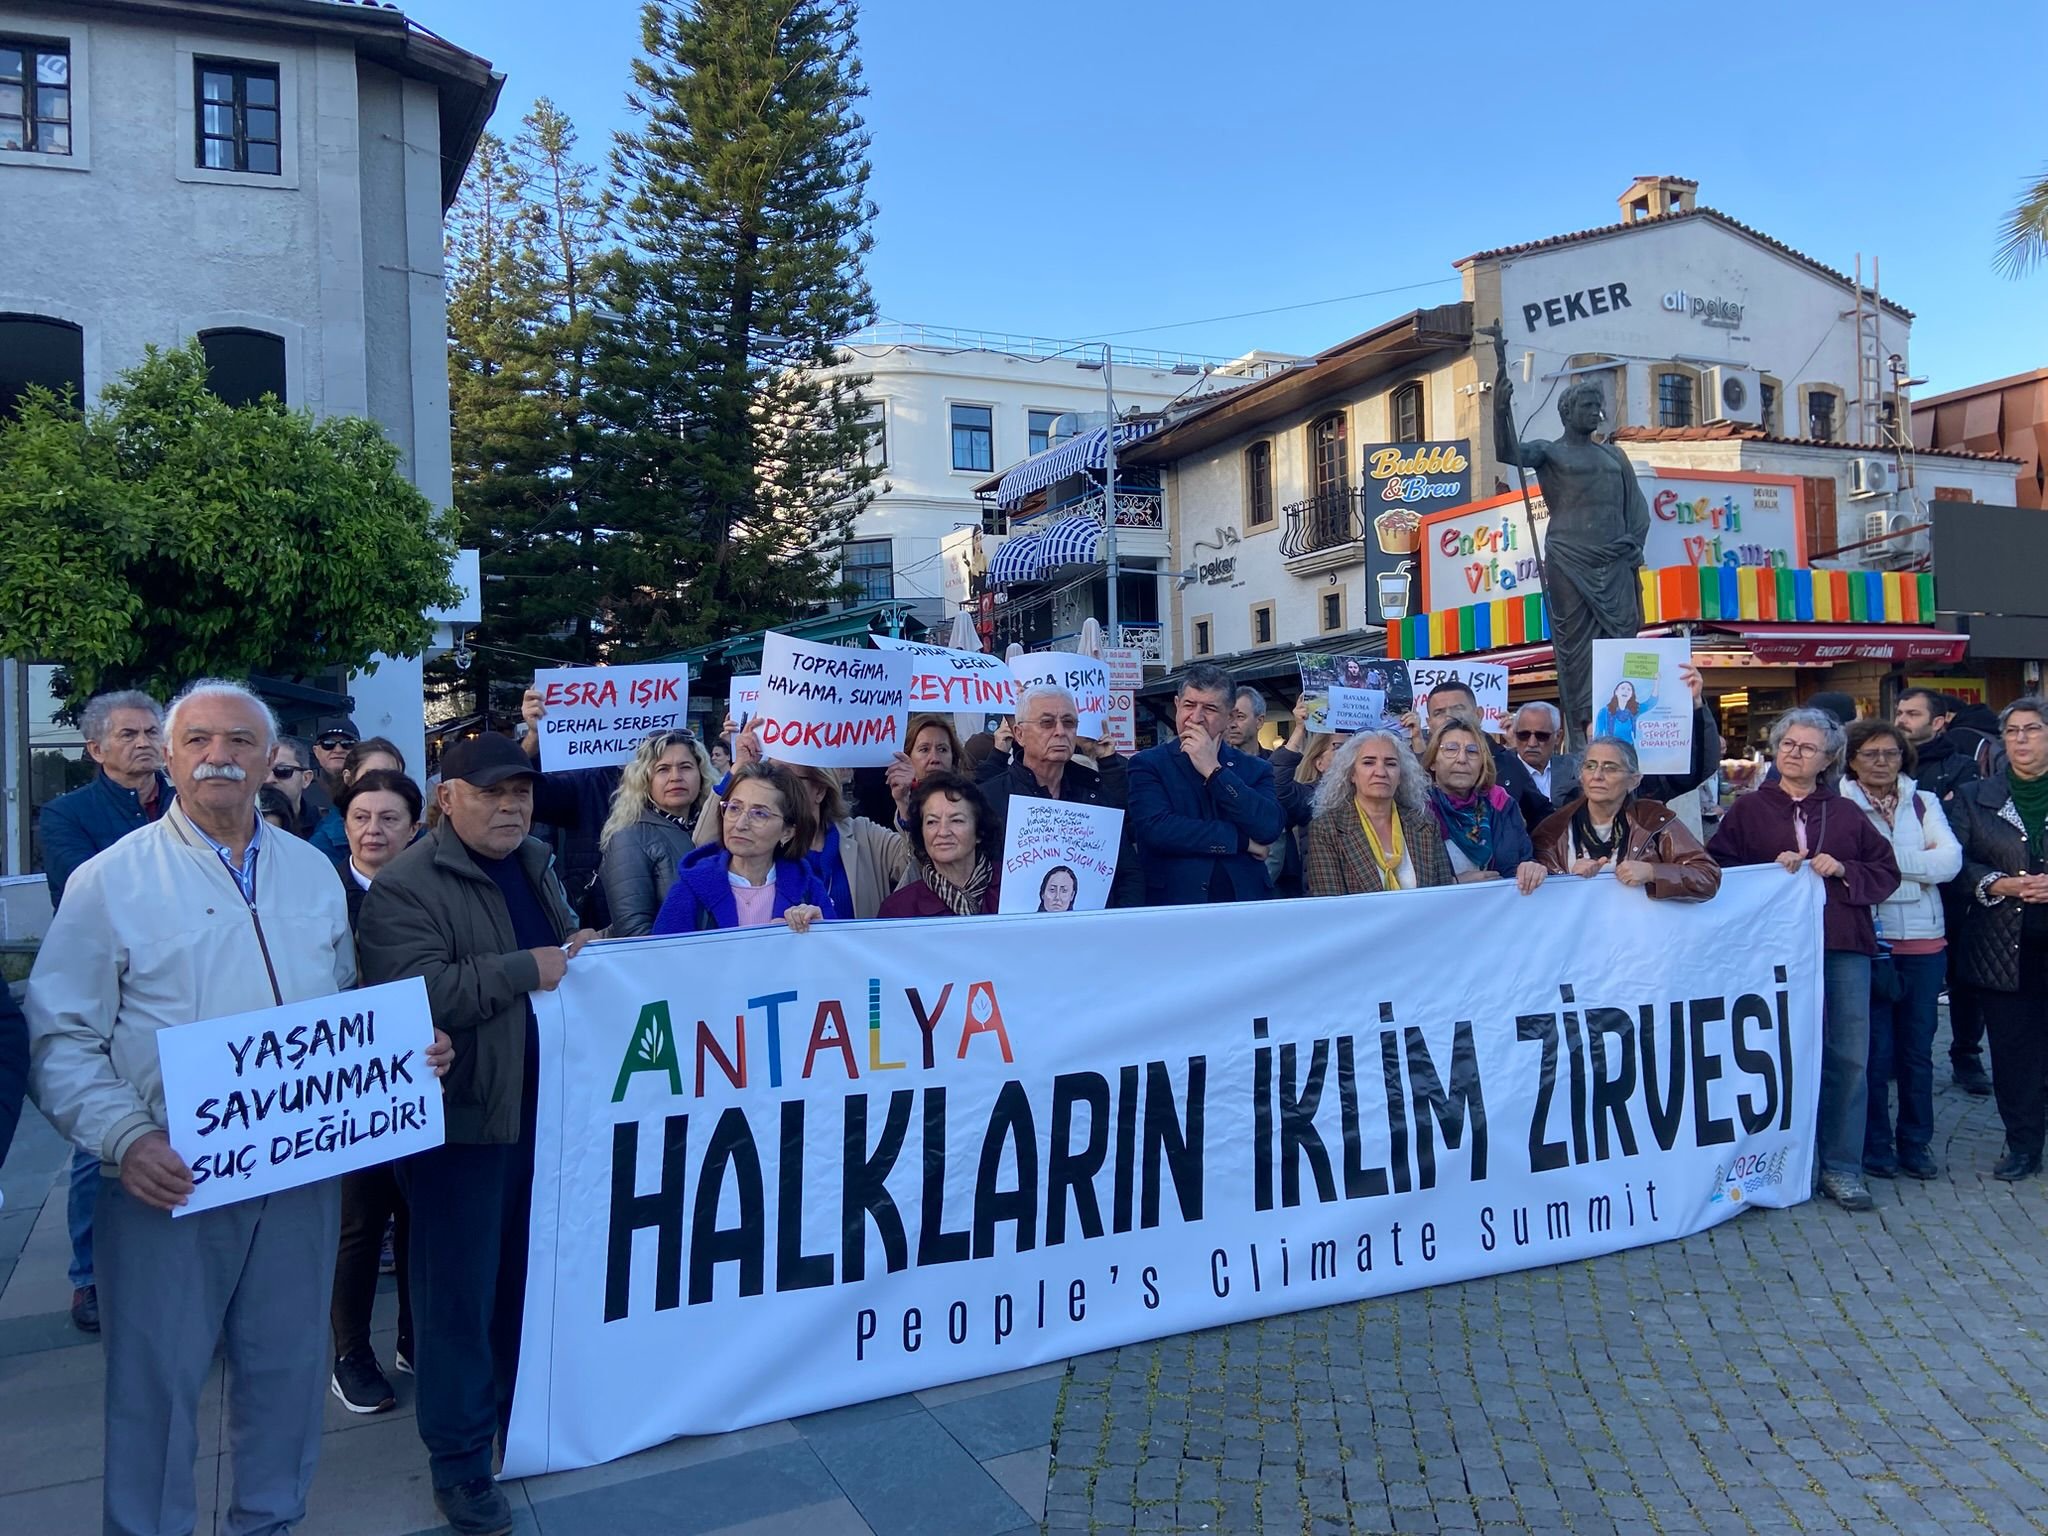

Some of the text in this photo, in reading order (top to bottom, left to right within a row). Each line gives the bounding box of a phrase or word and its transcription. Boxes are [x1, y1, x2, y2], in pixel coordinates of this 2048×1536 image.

[1522, 282, 1632, 333] PEKER
[1369, 447, 1468, 479] Bubble
[1753, 488, 1778, 499] DEVREN
[1654, 489, 1742, 533] enerji
[1440, 516, 1518, 557] enerji
[1683, 534, 1788, 568] vitamin
[1200, 556, 1237, 584] peker
[792, 653, 889, 681] TOPRAĞIMA,
[951, 656, 998, 670] DEĞİL
[1065, 668, 1106, 691] IŞIK'A
[544, 677, 681, 709] ESRA IŞIK
[767, 674, 903, 707] HAVAMA, SUYUMA
[910, 673, 1015, 706] ZEYTİN!
[1414, 670, 1503, 692] ESRA IŞIK
[547, 713, 678, 734] DERHAL SERBEST
[763, 715, 897, 749] DOKUNMA
[1006, 846, 1061, 873] ESRA'NIN
[227, 1010, 375, 1077] YAŞAMI
[611, 978, 1014, 1103] ANTALYA
[195, 1050, 415, 1137] SAVUNMAK
[192, 1095, 428, 1185] SUÇ DEĞİLDİR!
[604, 965, 1793, 1324] HALKLARIN İKLİM ZİRVESİ
[1726, 1151, 1767, 1182] 2026
[1211, 1221, 1437, 1298] Climate
[1481, 1179, 1661, 1252] Summit
